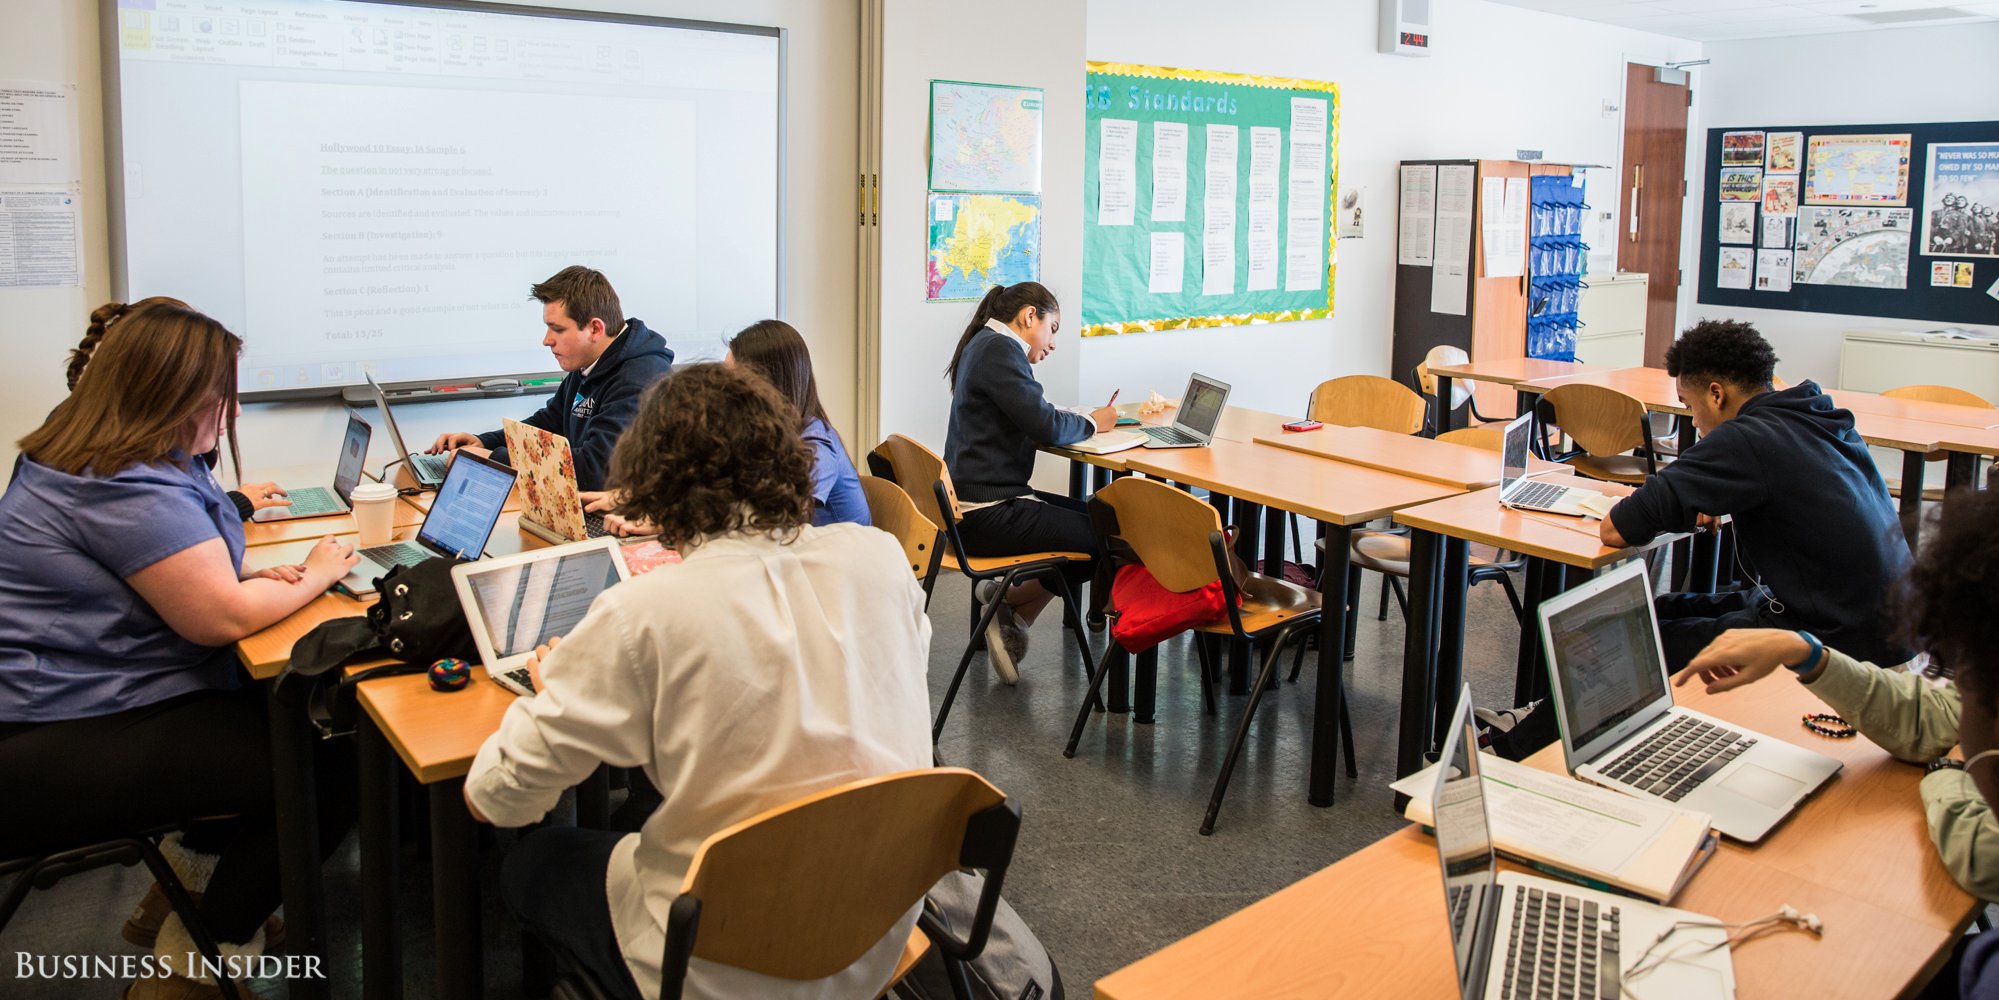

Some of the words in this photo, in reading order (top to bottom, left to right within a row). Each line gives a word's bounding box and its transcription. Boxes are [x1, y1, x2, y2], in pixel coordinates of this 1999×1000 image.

[1128, 86, 1238, 115] Standards
[320, 143, 371, 154] Hollywood
[373, 144, 385, 153] 10
[386, 144, 413, 154] Essay:
[425, 145, 457, 155] Sample
[1962, 152, 1977, 160] WAS
[1978, 152, 1987, 160] SO
[320, 166, 338, 175] The
[339, 167, 380, 177] question
[423, 168, 449, 177] strong
[1938, 163, 1960, 171] OWED
[1961, 163, 1972, 171] BY
[1973, 163, 1983, 171] SO
[1737, 174, 1754, 184] THIS
[1938, 174, 1948, 182] TO
[1949, 174, 1959, 182] SO
[320, 188, 356, 197] Section
[357, 188, 364, 197] A
[365, 187, 430, 198] (Identification
[432, 188, 448, 196] and
[449, 188, 494, 197] Evaluation
[321, 209, 356, 218] Sources
[373, 208, 413, 217] identified
[414, 209, 430, 217] and
[473, 208, 488, 216] The
[515, 208, 530, 216] and
[321, 231, 357, 241] Section
[358, 231, 365, 240] B
[366, 230, 436, 241] (Investigation):
[323, 254, 335, 263] An
[336, 254, 370, 264] attempt
[371, 253, 387, 262] has
[389, 252, 409, 261] been
[410, 252, 433, 260] made
[322, 264, 361, 274] contains
[362, 263, 392, 273] limited
[393, 262, 421, 272] critical
[323, 286, 358, 296] Section
[359, 286, 366, 295] C
[366, 283, 422, 296] (Reflection):
[324, 309, 344, 318] This
[353, 309, 374, 320] poor
[375, 307, 391, 317] and
[399, 307, 421, 317] good
[422, 305, 456, 316] example
[325, 331, 353, 341] Total:
[354, 329, 383, 340] 13/25
